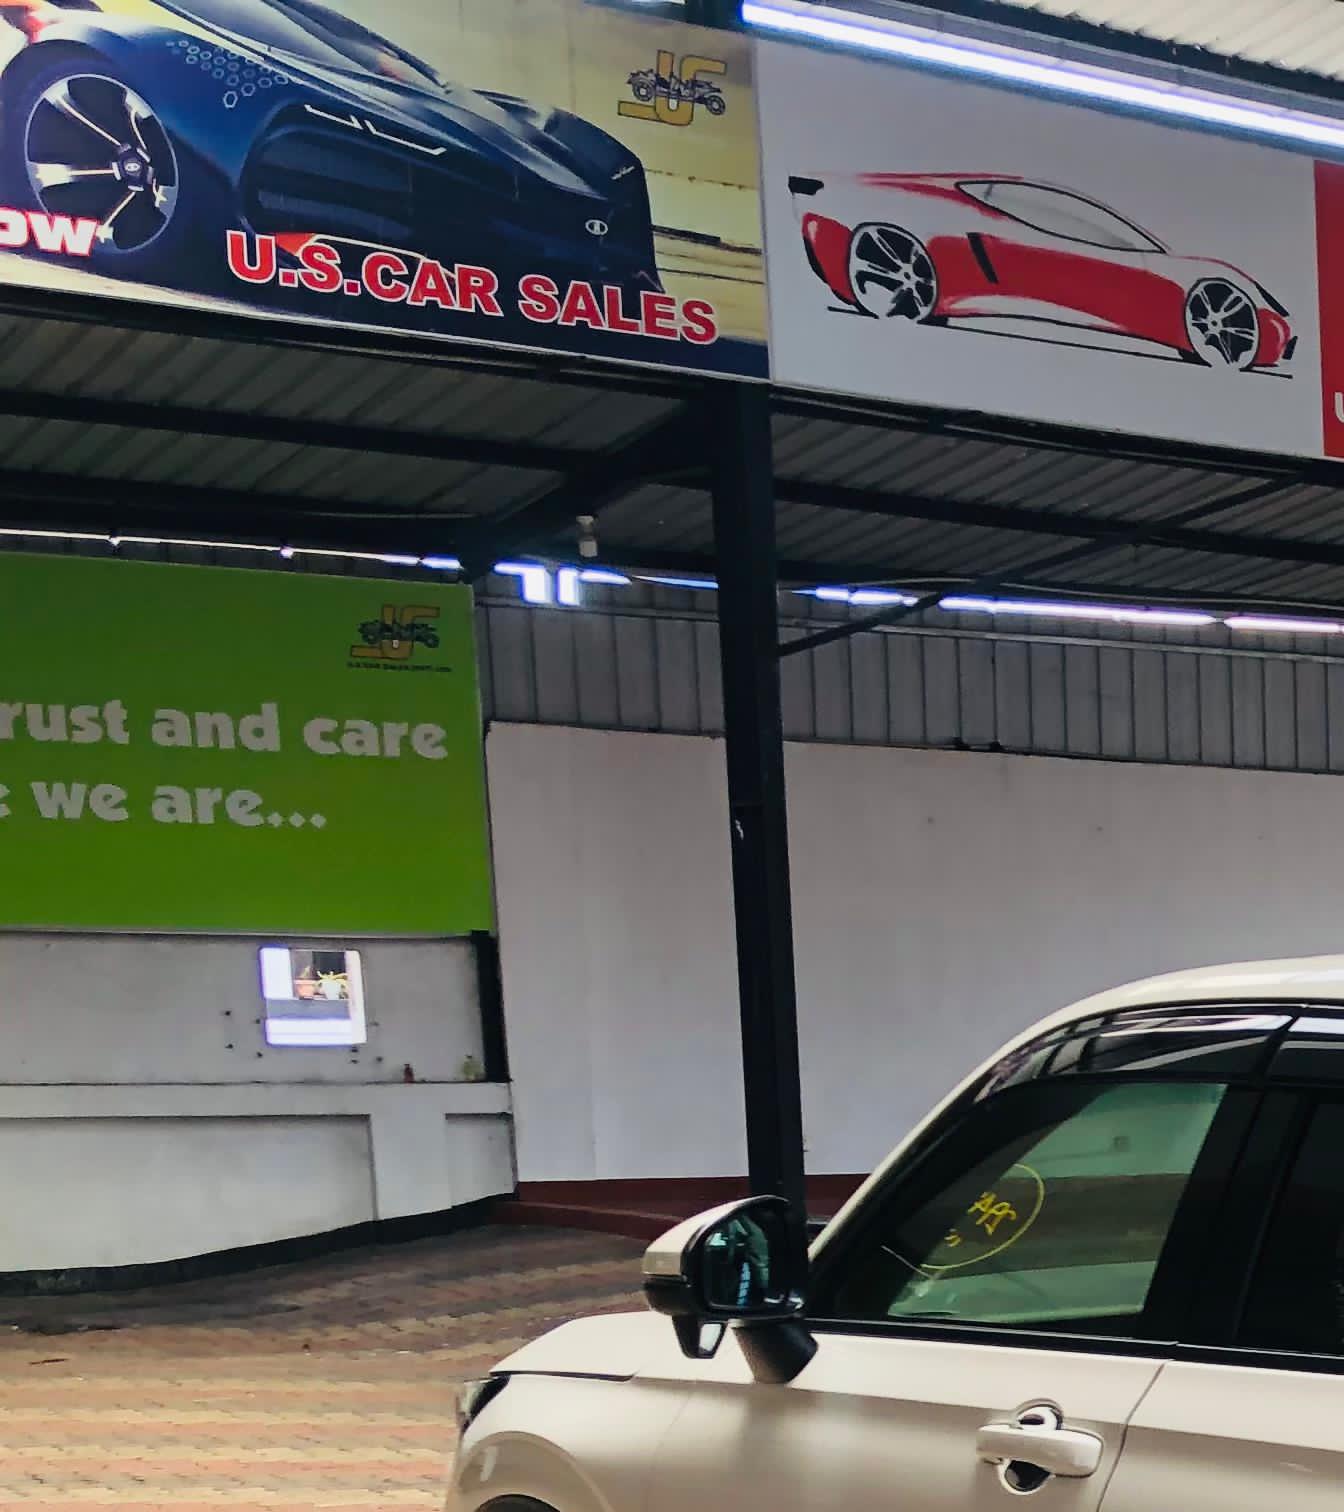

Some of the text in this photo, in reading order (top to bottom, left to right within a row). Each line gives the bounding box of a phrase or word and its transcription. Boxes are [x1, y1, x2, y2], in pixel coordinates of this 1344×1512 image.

[226, 230, 719, 346] U.S.CAR SALES
[151, 702, 281, 752] and
[303, 717, 448, 760] care
[30, 781, 129, 821] we
[151, 786, 327, 829] are...
